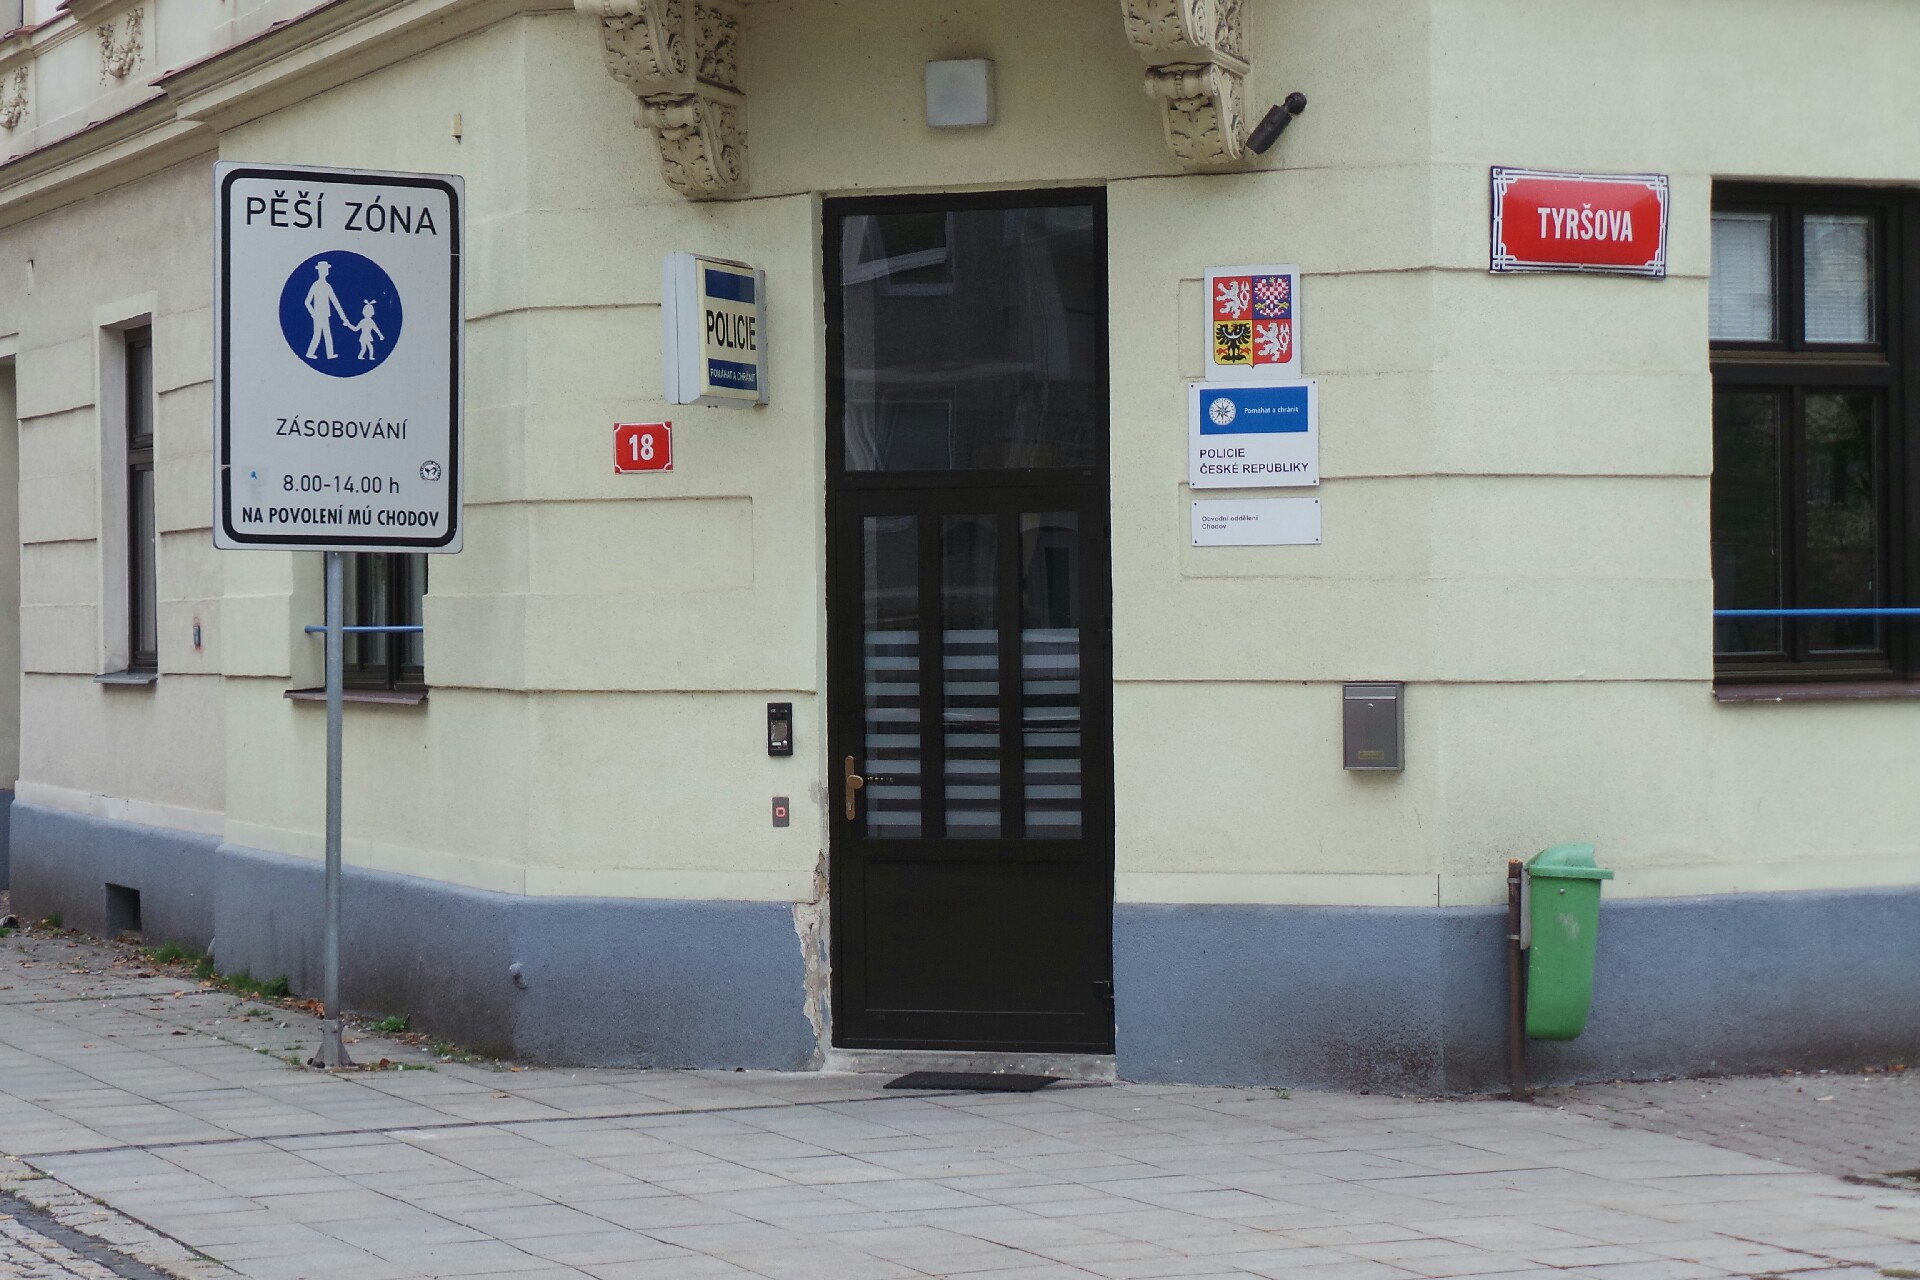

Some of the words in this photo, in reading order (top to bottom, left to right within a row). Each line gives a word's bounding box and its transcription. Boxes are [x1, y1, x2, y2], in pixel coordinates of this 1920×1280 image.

[246, 190, 324, 228] PĚŠÍ
[344, 195, 437, 236] ZÓNA
[1537, 203, 1633, 242] TYRŠOVA
[706, 309, 756, 351] POLICIE
[1244, 406, 1270, 414] Pomáhat
[1277, 406, 1299, 414] chránit
[275, 415, 408, 440] ZÁSOBOVÁNÍ
[629, 434, 654, 461] 18
[1199, 448, 1246, 459] POLICIE
[1199, 461, 1239, 475] ČESKÉ
[1242, 462, 1309, 474] REPUBLIKY
[283, 474, 382, 494] 8.00-14.00
[389, 477, 400, 494] h
[242, 506, 263, 524] NA
[269, 504, 343, 525] POVOLENÍ
[348, 504, 372, 526] MÚ
[377, 508, 440, 528] CHODOV
